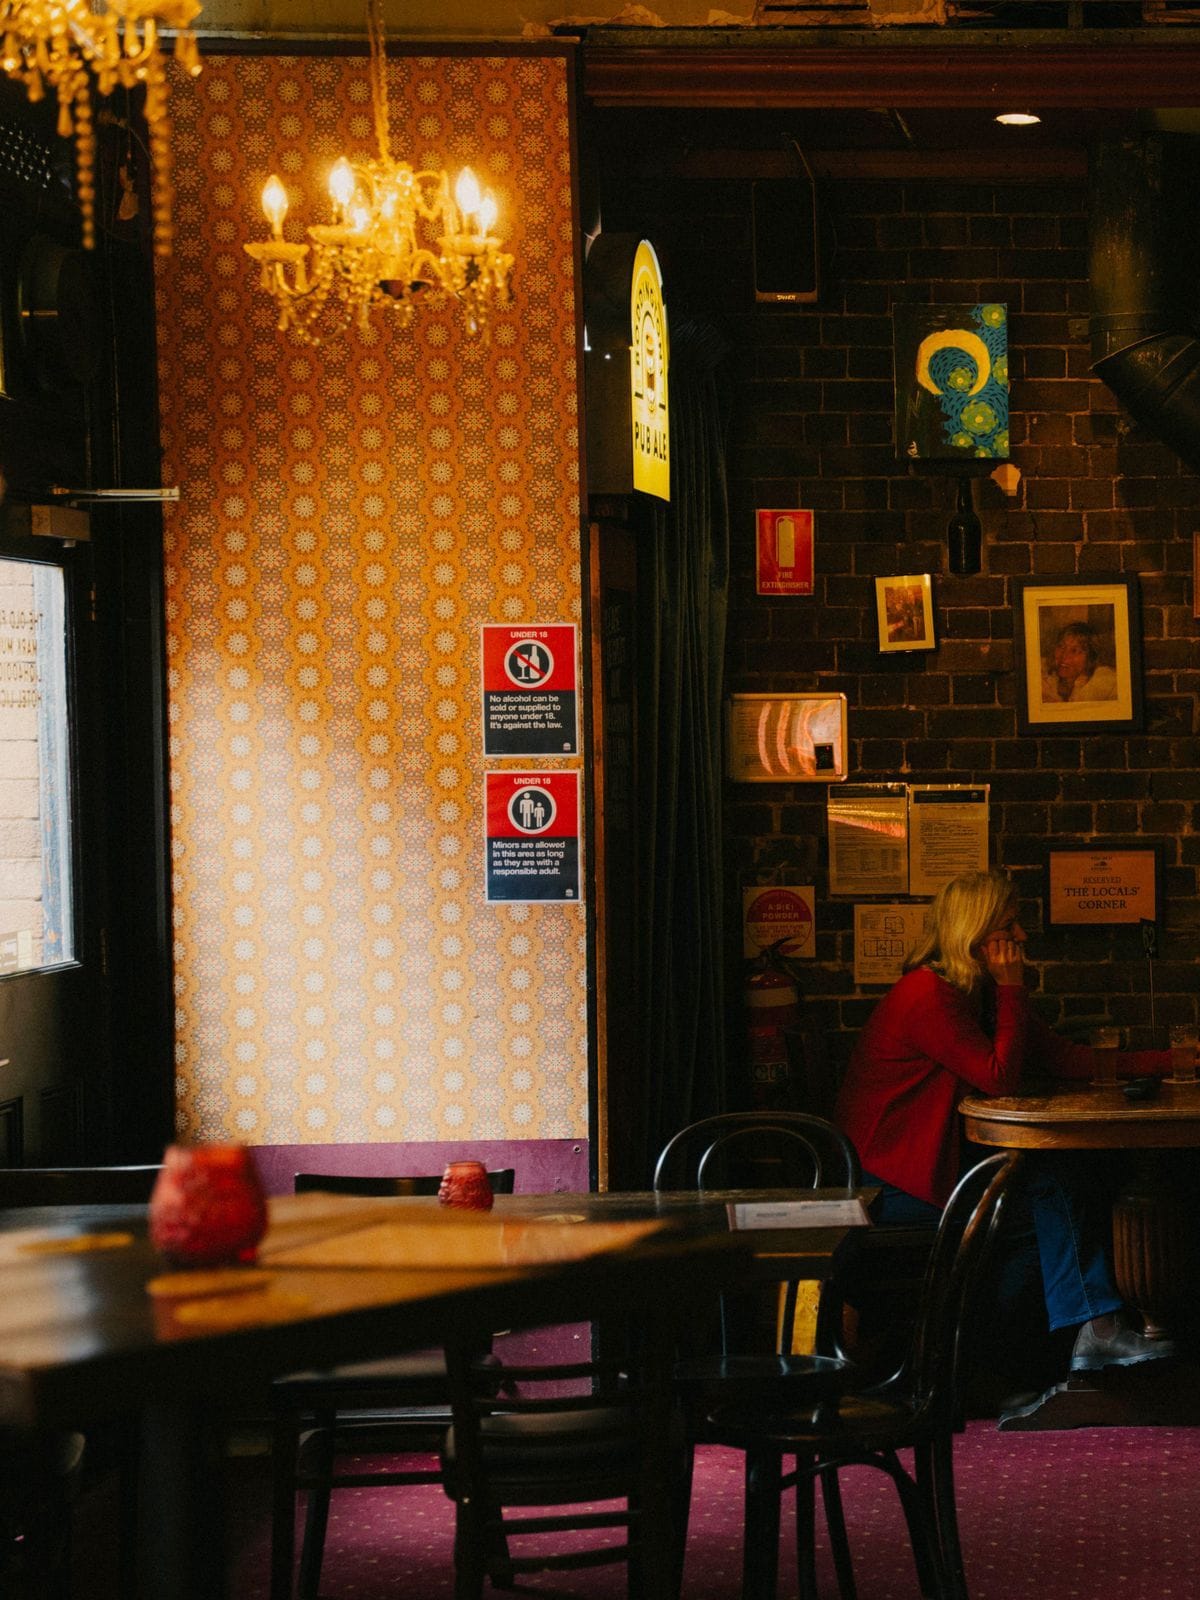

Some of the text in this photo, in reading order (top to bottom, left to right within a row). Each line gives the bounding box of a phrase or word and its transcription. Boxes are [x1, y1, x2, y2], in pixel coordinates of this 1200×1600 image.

[634, 421, 667, 461] PUB ALE
[510, 631, 538, 639] UNDER
[489, 695, 501, 703] No
[502, 695, 532, 703] alcohol
[548, 694, 559, 702] be
[489, 703, 507, 711] sold
[518, 703, 551, 713] supplied
[489, 721, 563, 730] It's against the law.
[513, 777, 551, 785] UNDER 18
[492, 841, 520, 849] Minors
[535, 841, 566, 849] allowed
[492, 850, 501, 858] in
[501, 850, 516, 858] this
[546, 850, 564, 859] long
[503, 859, 521, 868] they
[536, 859, 553, 867] with
[492, 868, 538, 876] responsible
[1082, 875, 1122, 884] RESERVED
[1064, 887, 1088, 897] THE
[1078, 899, 1128, 910] CORNER
[762, 912, 800, 921] POWDER
